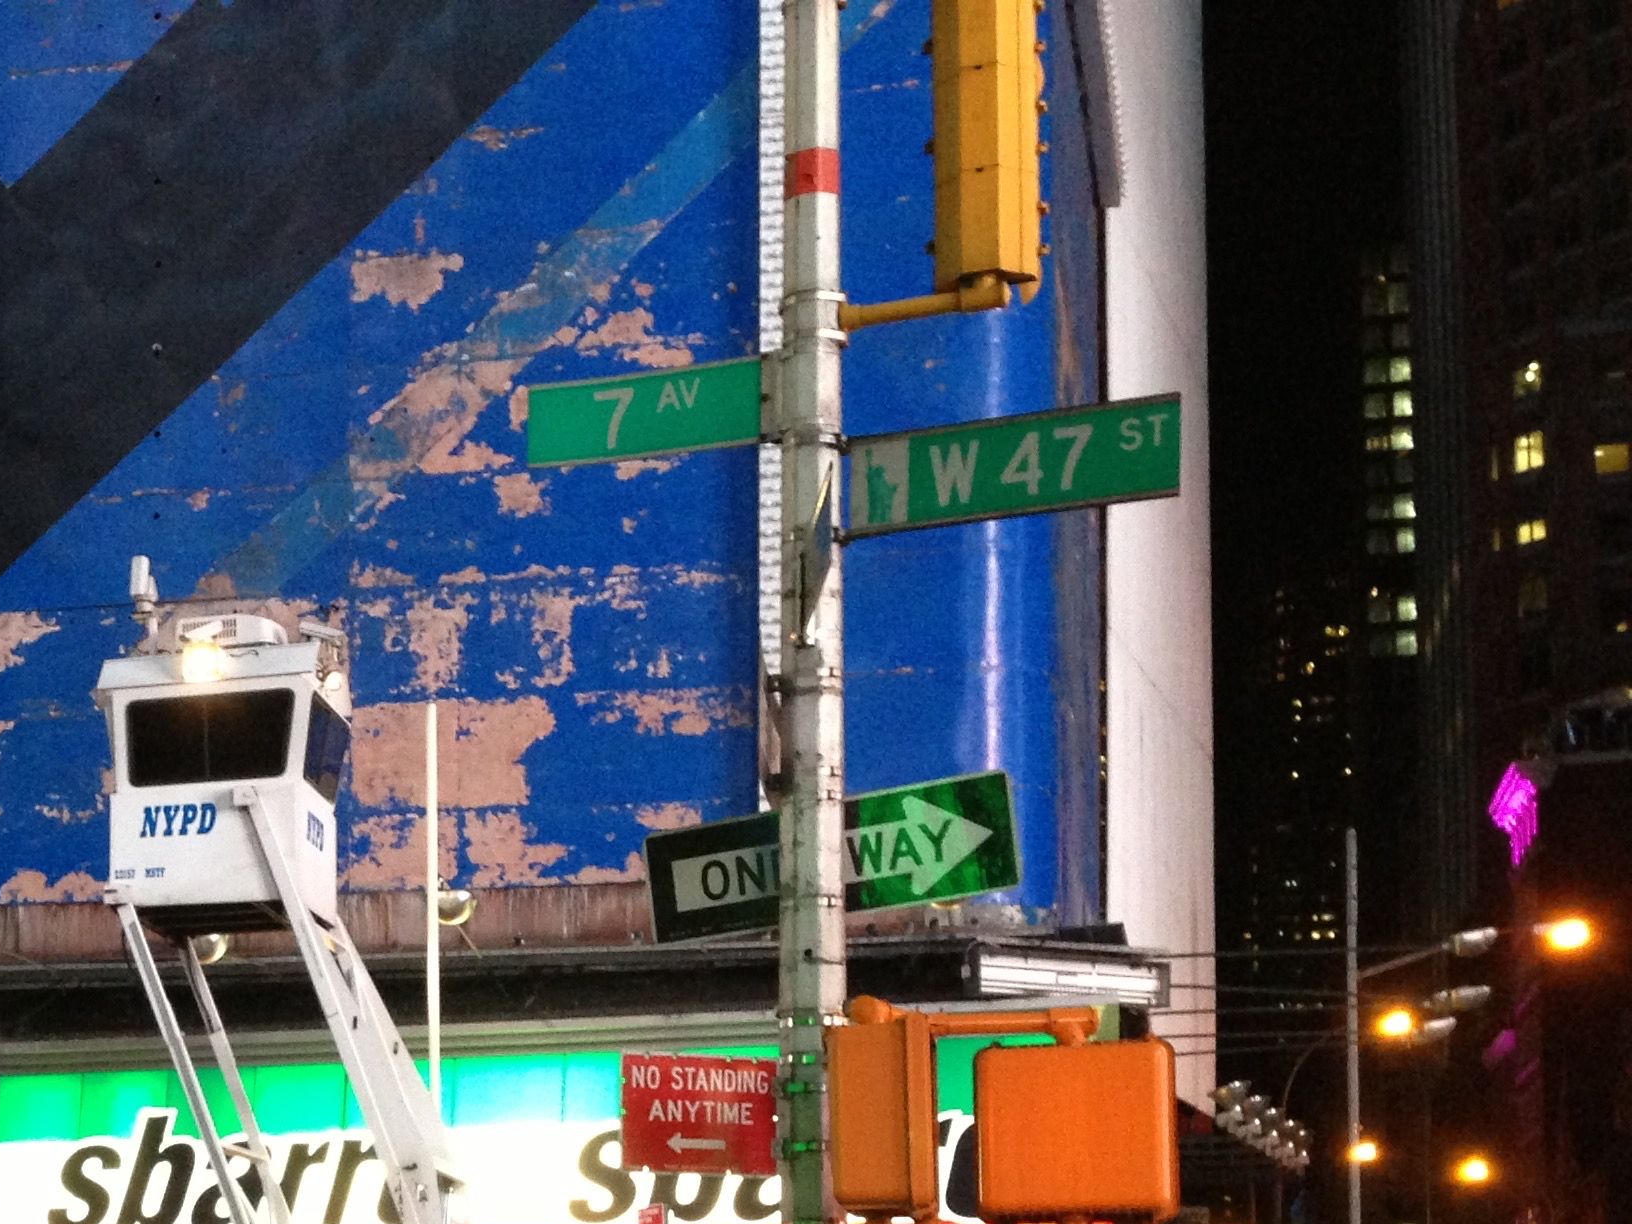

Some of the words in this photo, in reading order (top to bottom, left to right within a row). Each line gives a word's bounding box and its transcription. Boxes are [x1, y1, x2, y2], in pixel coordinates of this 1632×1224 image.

[593, 387, 635, 450] 7
[656, 376, 701, 414] AV
[929, 438, 981, 508] W
[999, 422, 1095, 497] 47
[1119, 412, 1170, 452] ST
[139, 802, 218, 839] NYPD
[306, 810, 325, 852] NYPD
[845, 818, 953, 877] WAY
[630, 1064, 661, 1090] NO
[670, 1066, 769, 1095] STANDING
[648, 1099, 754, 1126] ANYTIME
